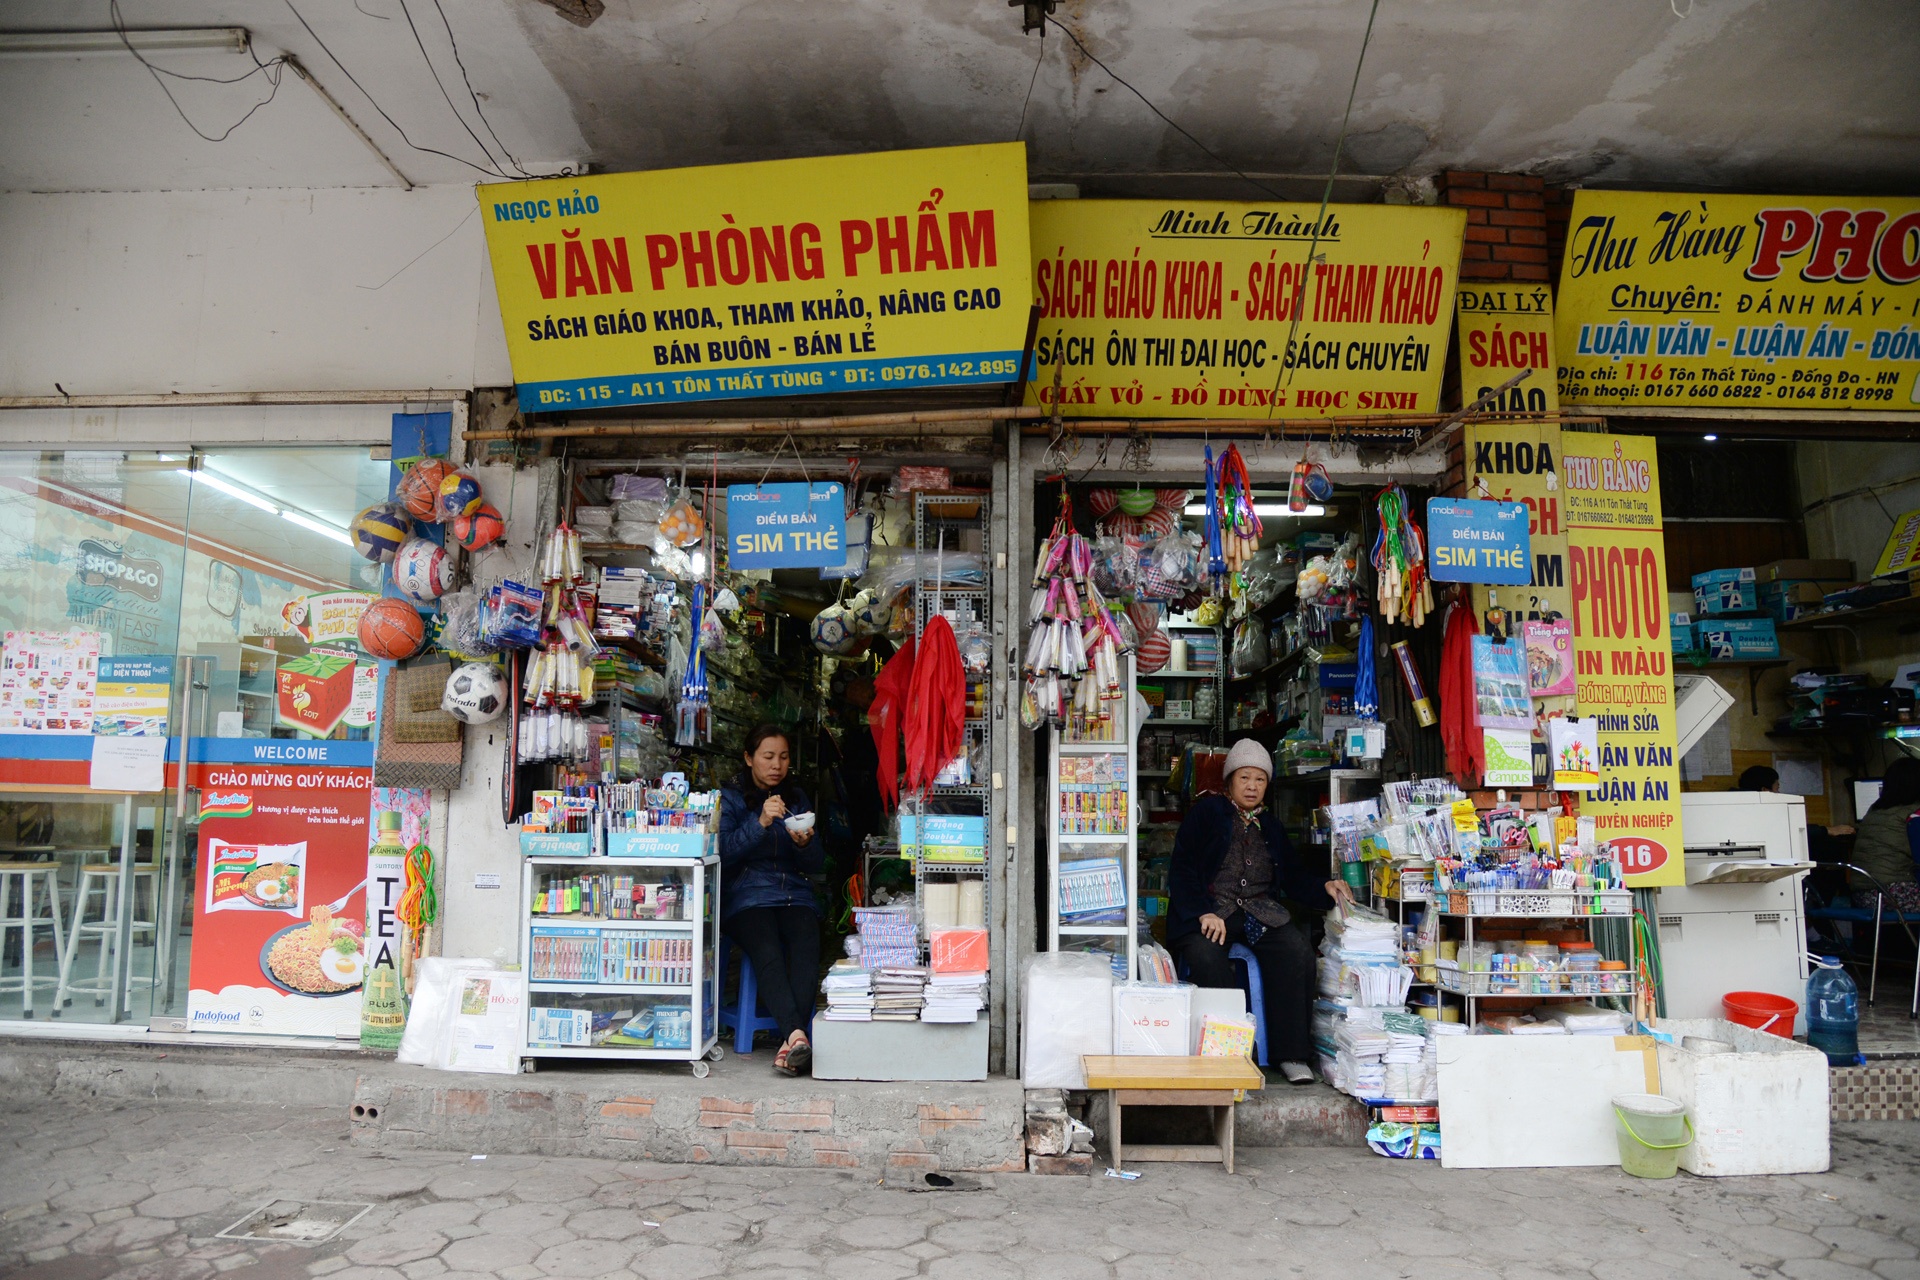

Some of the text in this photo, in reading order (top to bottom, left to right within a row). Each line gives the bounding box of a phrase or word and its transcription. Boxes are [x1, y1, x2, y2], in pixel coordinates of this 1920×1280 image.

[494, 189, 599, 223] NGỌC HẢO
[1148, 210, 1341, 237] Minh Thành
[526, 188, 997, 300] VĂN PHÒNG PHẨM
[1571, 216, 1638, 278] Thu
[1648, 201, 1746, 264] Hằng
[1036, 240, 1443, 326] SÁCH GIÁO KHOA SÁCH THAM KHẢO
[1460, 288, 1548, 315] ĐẠI LÝ
[1611, 284, 1722, 314] Chuyên:
[1737, 288, 1815, 314] ĐÁNH
[1824, 290, 1885, 316] MÁY
[528, 287, 1001, 341] SÁCH GIÁO KHOA, THAM KHẢO, NÂNG CAO
[653, 322, 876, 366] BÁN BUÔN BÁN LẺ
[1468, 323, 1549, 369] SÁCH
[1577, 319, 1651, 361] LUẬN
[1656, 320, 1713, 356] VĂN
[1733, 322, 1805, 362] LUẬN
[1807, 323, 1850, 358] ÁN
[1038, 329, 1430, 377] SÁCH ÔN THI ĐẠI HỌC SÁCH CHUYÊN
[539, 360, 1017, 404] ĐC: 115 A11 TÔN THẤT TÙNG ĐT: 0976.142.895
[1557, 366, 1585, 383] Địa
[1590, 366, 1618, 380] chỉ:
[1670, 368, 1695, 381] Tôn
[1702, 366, 1735, 381] Thất
[1741, 369, 1776, 385] Tùng
[1792, 368, 1832, 386] Đống
[1838, 371, 1860, 384] Đa
[1876, 372, 1900, 385] HN
[1040, 376, 1418, 414] GIẤY VỞ ĐỒ DÙNG HỌC SINH
[1558, 384, 1894, 401] Điện thoại: 0167 660 6822 0164 812 8998
[1476, 442, 1555, 474] KHOA
[1563, 440, 1650, 493] THU HẰNG
[732, 492, 780, 501] mobifone
[1583, 497, 1593, 507] 116
[756, 511, 817, 525] ĐIỂM BÁN
[1432, 506, 1473, 515] mobifone
[736, 525, 838, 554] SIM THẺ
[1453, 527, 1504, 541] ĐIỂM BÁN
[1436, 544, 1524, 568] SIM THẺ
[85, 555, 158, 587] SHOP&GO
[1569, 546, 1661, 640] PHOTO
[124, 618, 160, 639] FAST
[1528, 624, 1569, 637] Tiếng Anh
[1557, 638, 1566, 650] 6
[1578, 646, 1666, 677] IN MÀU
[1578, 682, 1666, 707] ĐÓNG MẠ VÀNG
[303, 710, 319, 720] 2017
[1634, 708, 1659, 731] SỬA
[254, 746, 327, 760] WELCOME
[1634, 742, 1672, 767] VĂN
[210, 770, 373, 788] CHÀO MỪNG QUÝ KHÁCH
[1488, 771, 1530, 785] Campus
[1643, 777, 1668, 801] ÁN
[257, 806, 281, 815] Hương
[283, 807, 289, 815] vị
[291, 806, 307, 815] được
[309, 807, 320, 815] yêu
[307, 815, 364, 826] trên toàn thế giới
[1632, 812, 1673, 830] NGHIỆP
[934, 822, 964, 830] Double
[540, 841, 582, 852] Double
[639, 842, 680, 853] Double
[216, 881, 249, 896] goreng
[194, 1010, 240, 1024] Indofood
